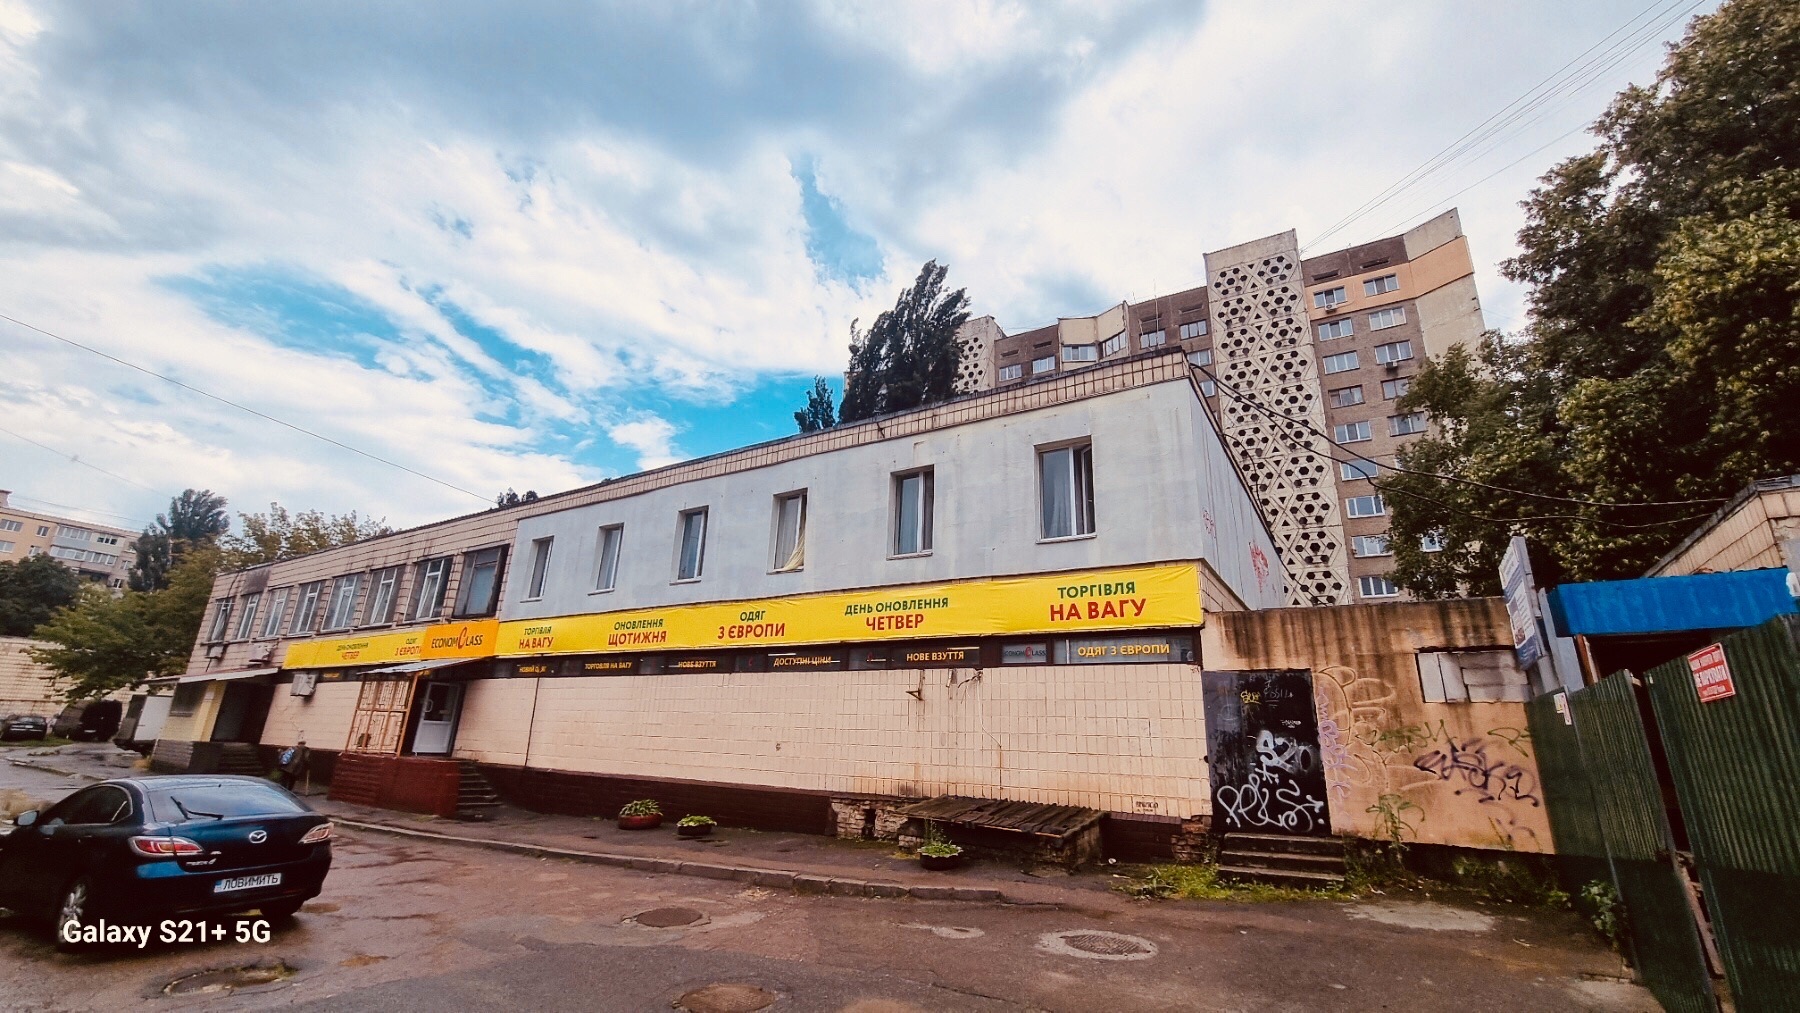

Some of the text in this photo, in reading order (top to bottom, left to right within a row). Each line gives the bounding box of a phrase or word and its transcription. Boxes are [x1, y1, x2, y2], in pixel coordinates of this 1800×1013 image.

[1057, 581, 1136, 599] ТОРГІВЛЯ
[845, 597, 949, 616] ДЕНЬ ОНОВЛЕННЯ
[1050, 598, 1147, 621] НА ВАГУ
[740, 610, 766, 622] ОДЯГ
[866, 613, 924, 631] ЧЕТВЕР
[524, 626, 552, 636] ТОРГІВЛЯ
[614, 619, 664, 630] ОНОВЛЕННЯ
[717, 623, 785, 639] З ЄВРОПИ
[519, 637, 554, 649] НА ВАГУ
[608, 631, 667, 646] ЩОТИЖНЯ
[906, 651, 965, 662] НОВЕ ВЗУТТЯ
[1077, 643, 1171, 657] ОДЯГ З ЄВРОПИ
[694, 660, 717, 668] ВЗУТТЯ
[223, 874, 279, 890] ЛОВИМИТЬ
